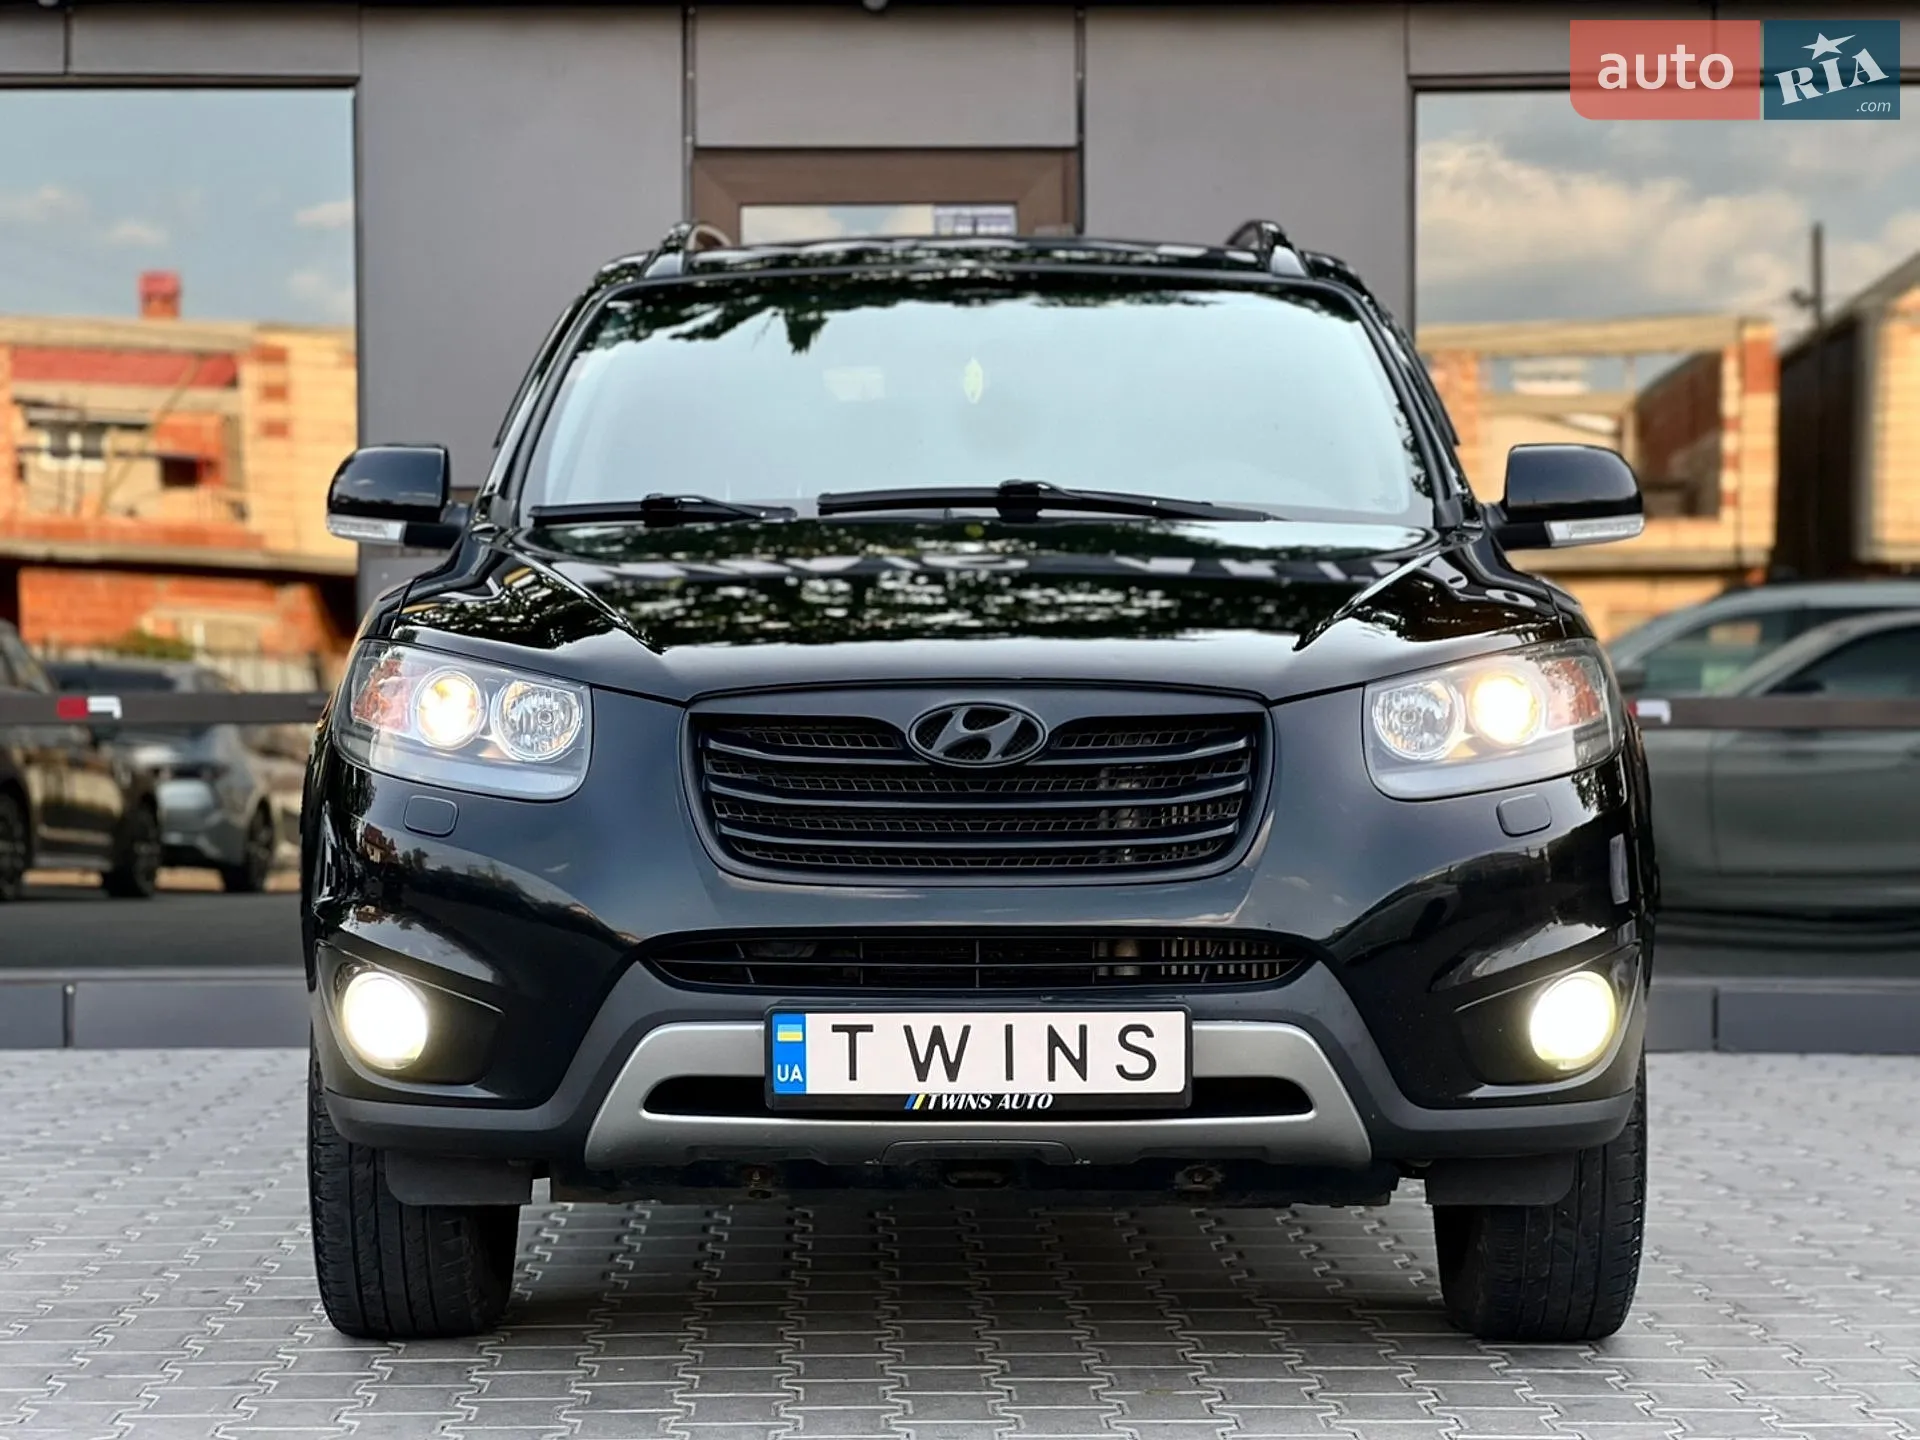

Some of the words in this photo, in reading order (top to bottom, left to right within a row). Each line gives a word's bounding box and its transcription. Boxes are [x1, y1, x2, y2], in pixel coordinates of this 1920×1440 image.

[831, 1024, 1157, 1082] TWINS
[777, 1064, 803, 1082] UA
[928, 1092, 991, 1110] TWINS
[997, 1092, 1053, 1110] AUTO
